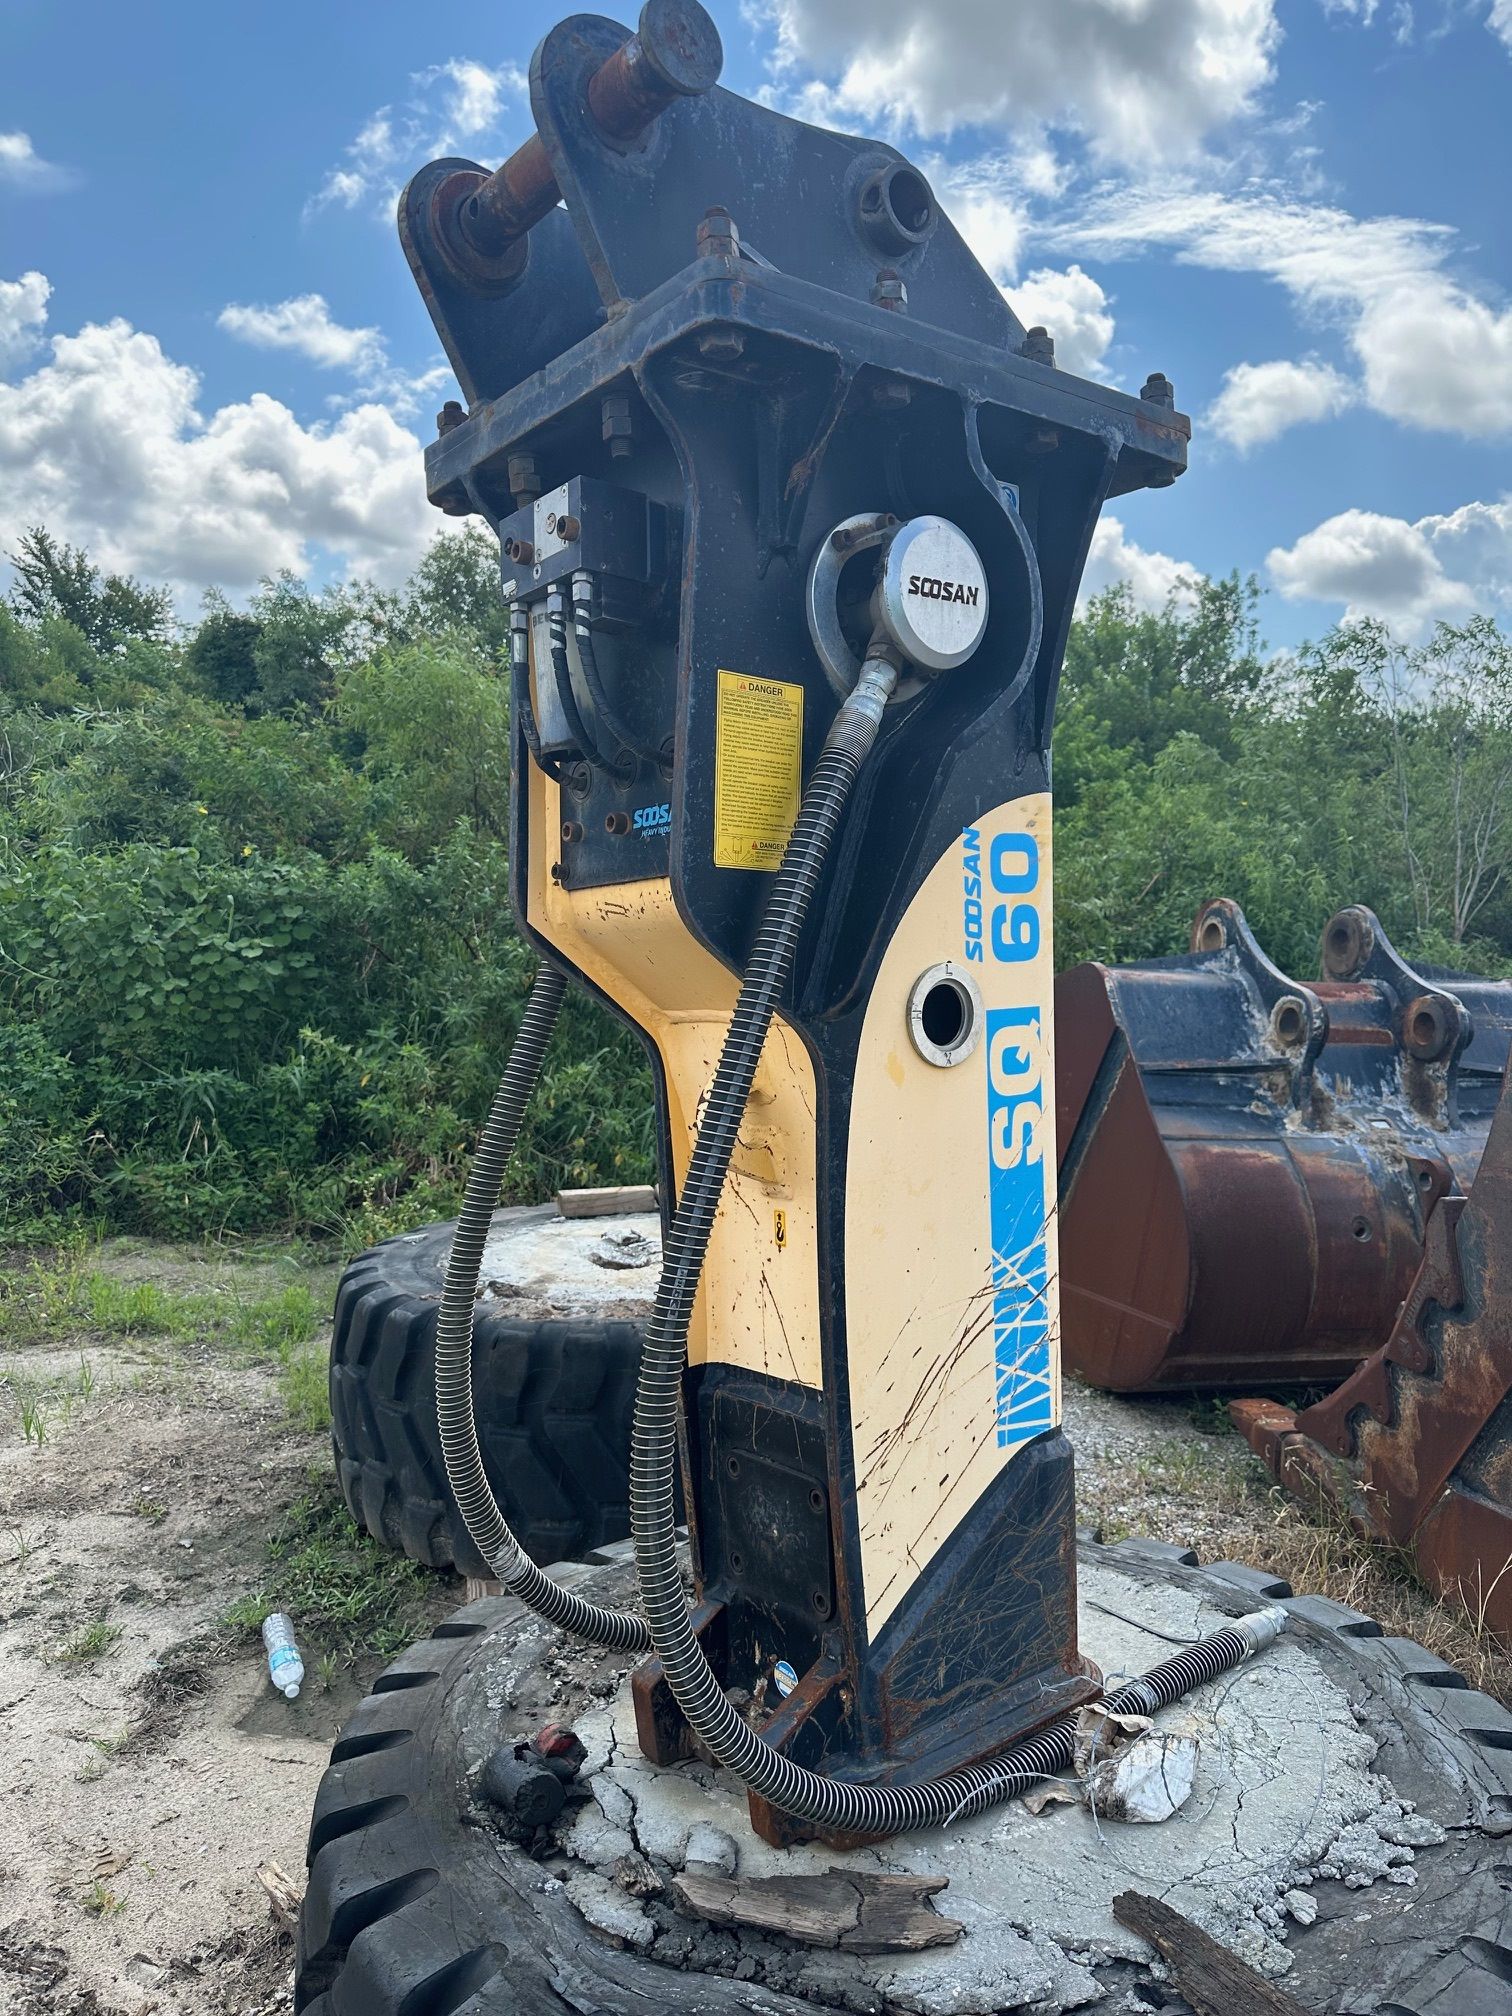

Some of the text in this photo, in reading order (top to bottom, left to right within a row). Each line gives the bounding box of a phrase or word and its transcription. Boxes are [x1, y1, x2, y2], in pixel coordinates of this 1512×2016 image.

[908, 575, 979, 606] SOOSAN
[748, 682, 783, 697] DANGER
[759, 842, 785, 850] DANGER
[963, 827, 983, 962] SOOSAN
[989, 833, 1043, 1170] SQ 60
